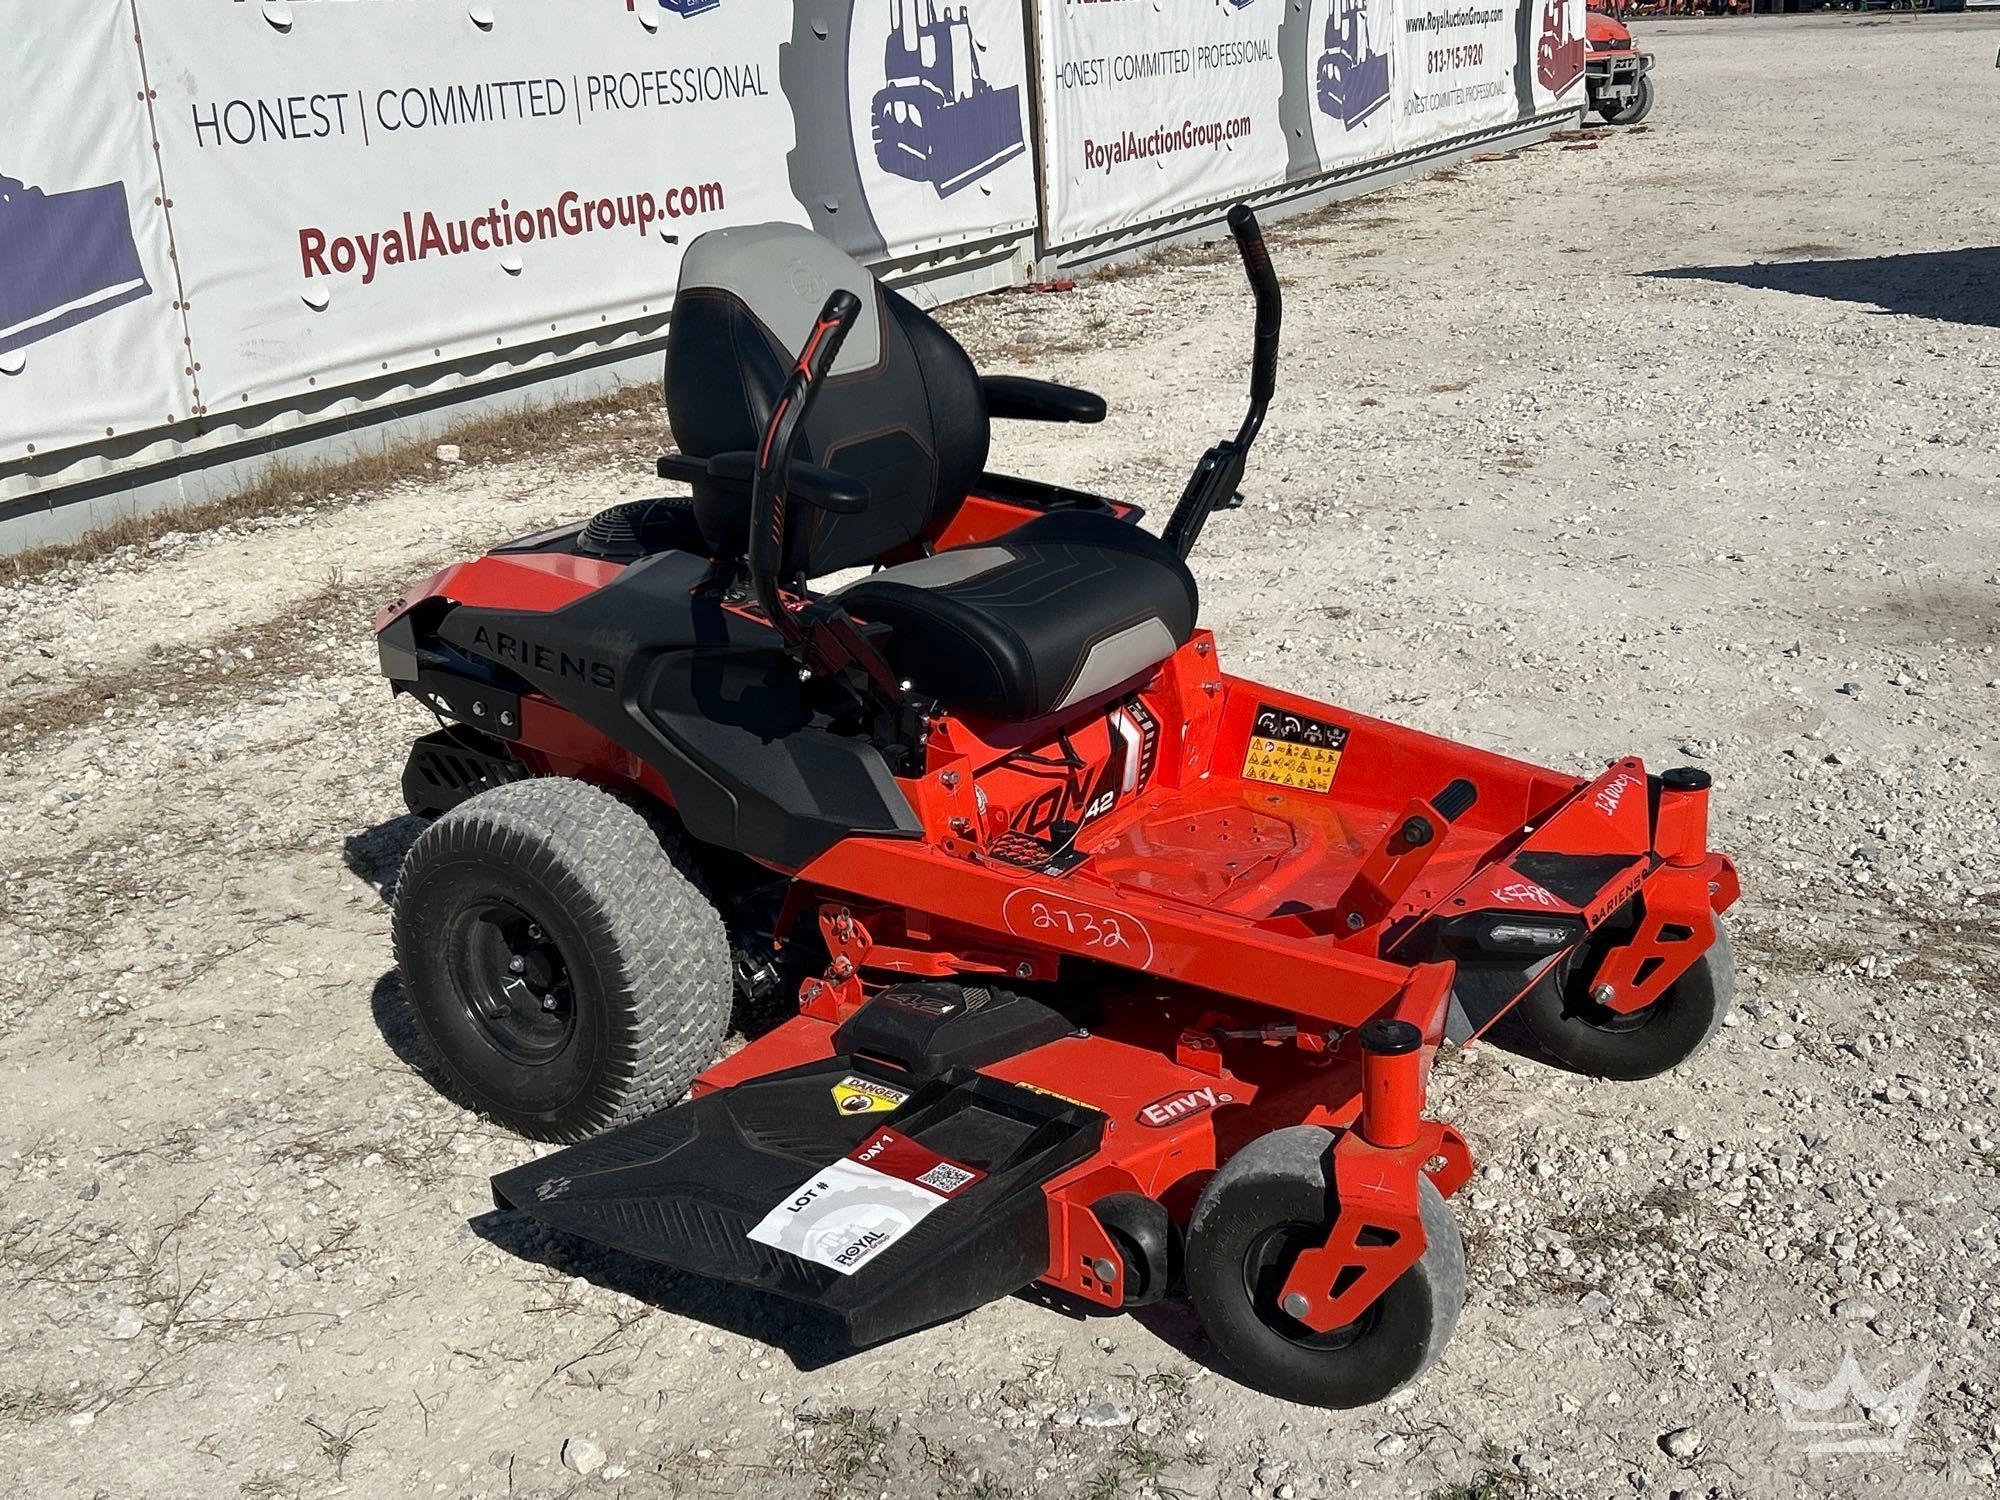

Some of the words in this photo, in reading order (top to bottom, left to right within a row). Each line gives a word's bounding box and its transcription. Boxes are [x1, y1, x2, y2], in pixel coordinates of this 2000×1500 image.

[1405, 6, 1504, 35] www.RoyalAuctionGroup.com
[1055, 58, 1105, 90] HONEST
[1113, 48, 1190, 82] COMMITTED
[1198, 39, 1273, 70] PROFESSIONAL
[1426, 43, 1483, 74] 813-715-7920
[191, 92, 349, 148] HONEST
[376, 78, 566, 131] COMMITTED
[586, 63, 769, 112] PROFESSIONAL
[1083, 115, 1251, 175] RoyalAuctionGroup.com
[298, 180, 724, 285] RoyalAuctionGroup.com
[472, 625, 616, 691] ARIENS
[1085, 790, 1114, 819] 42
[1599, 873, 1642, 918] ARIENS
[1030, 902, 1132, 951] 2732
[849, 1079, 904, 1102] DANGER
[1141, 1086, 1218, 1124] Envy
[858, 1141, 885, 1162] DAY
[882, 1134, 894, 1143] 1
[787, 1188, 820, 1214] LOT
[817, 1181, 830, 1191] #
[834, 1229, 886, 1266] ROYAL
